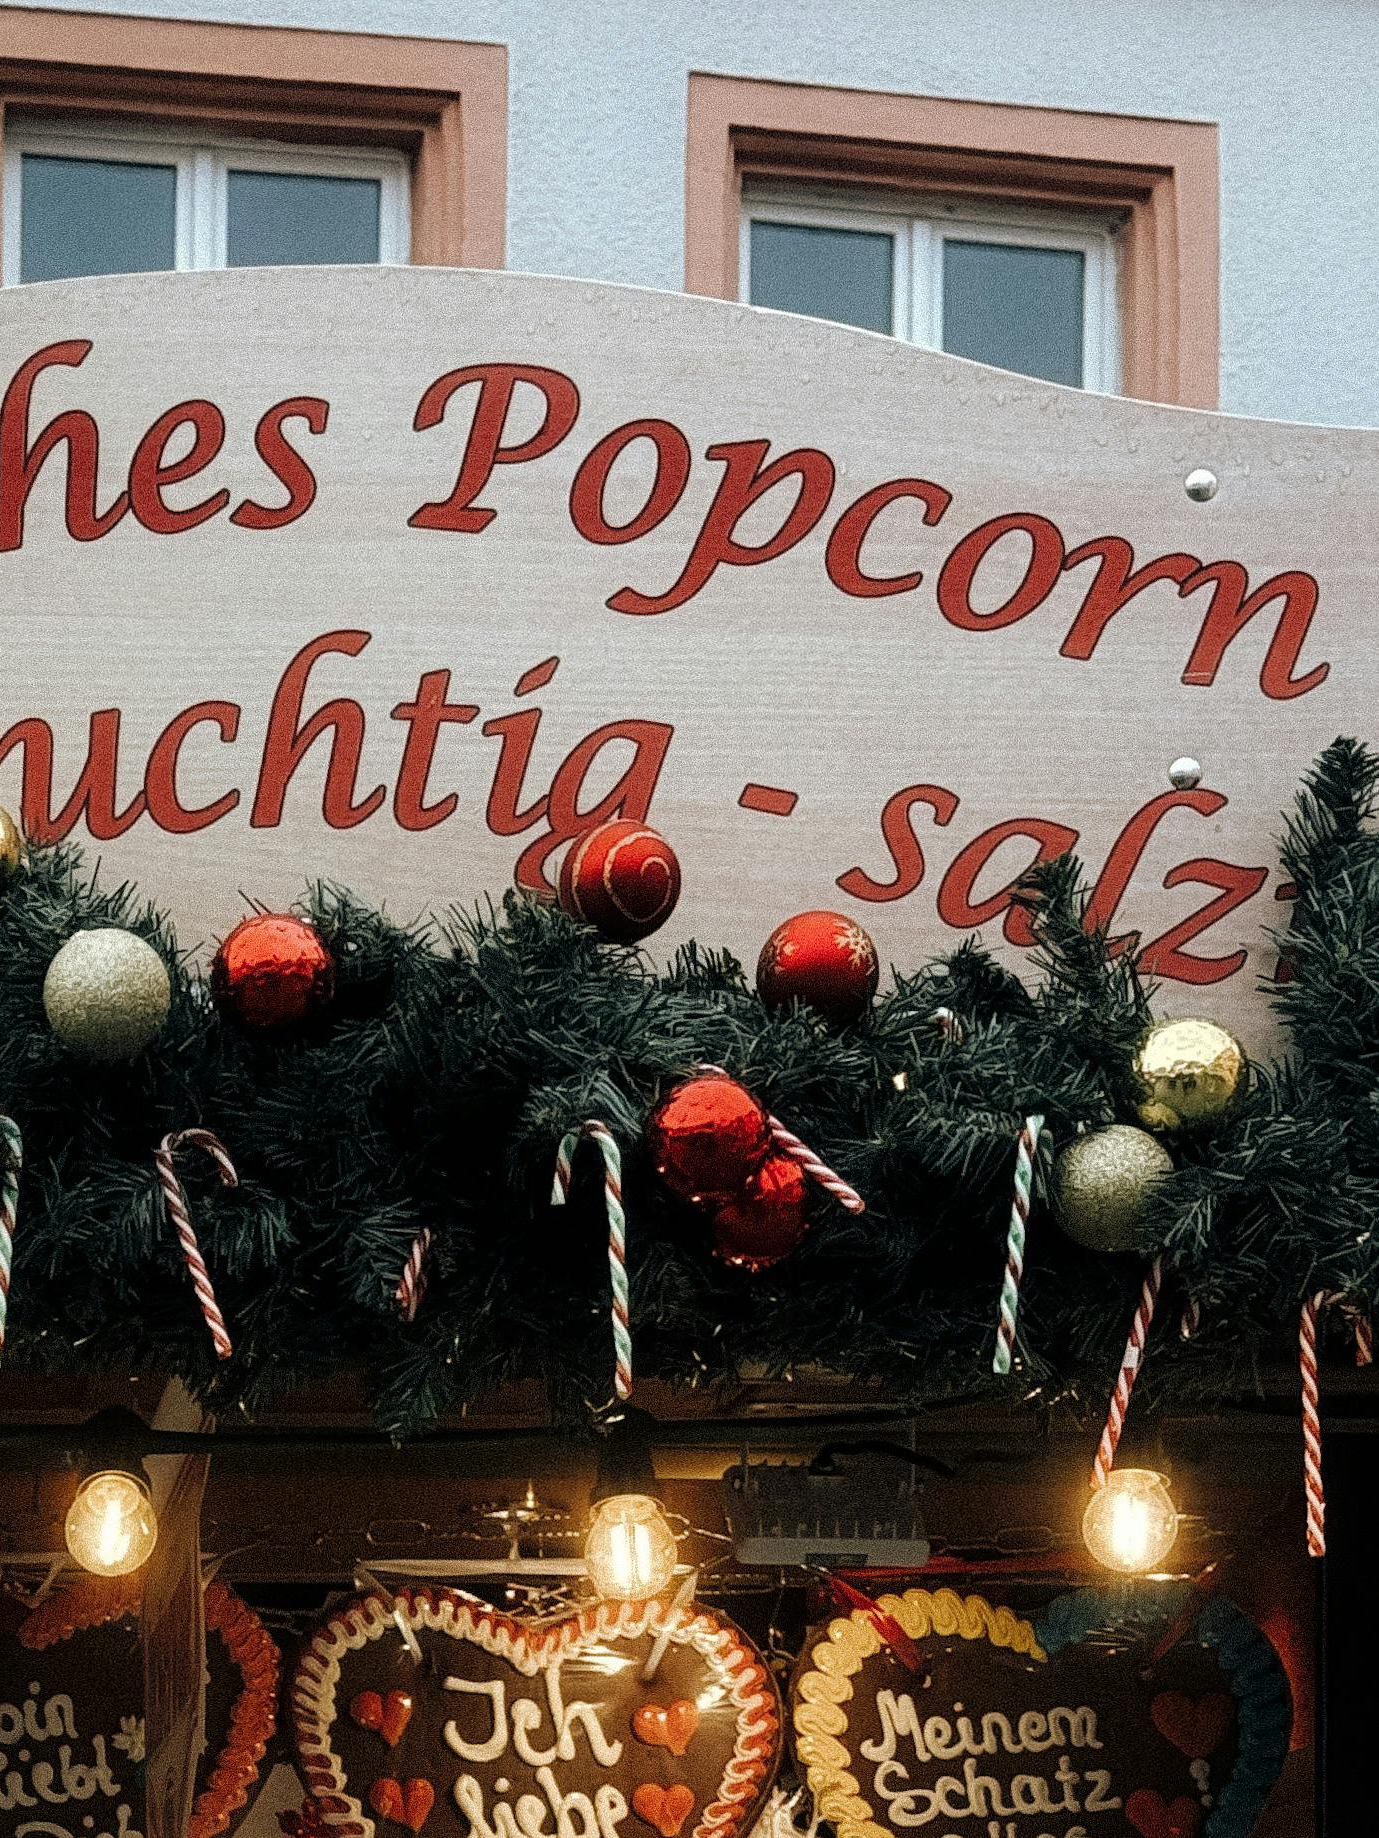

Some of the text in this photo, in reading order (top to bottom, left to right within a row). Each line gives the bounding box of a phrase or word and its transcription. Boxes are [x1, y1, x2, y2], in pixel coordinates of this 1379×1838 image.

[407, 361, 1331, 700] Popcorn
[738, 781, 798, 817] -
[443, 1660, 623, 1767] Ich
[860, 1688, 1103, 1763] Meinem
[874, 1755, 1122, 1827] Schatz
